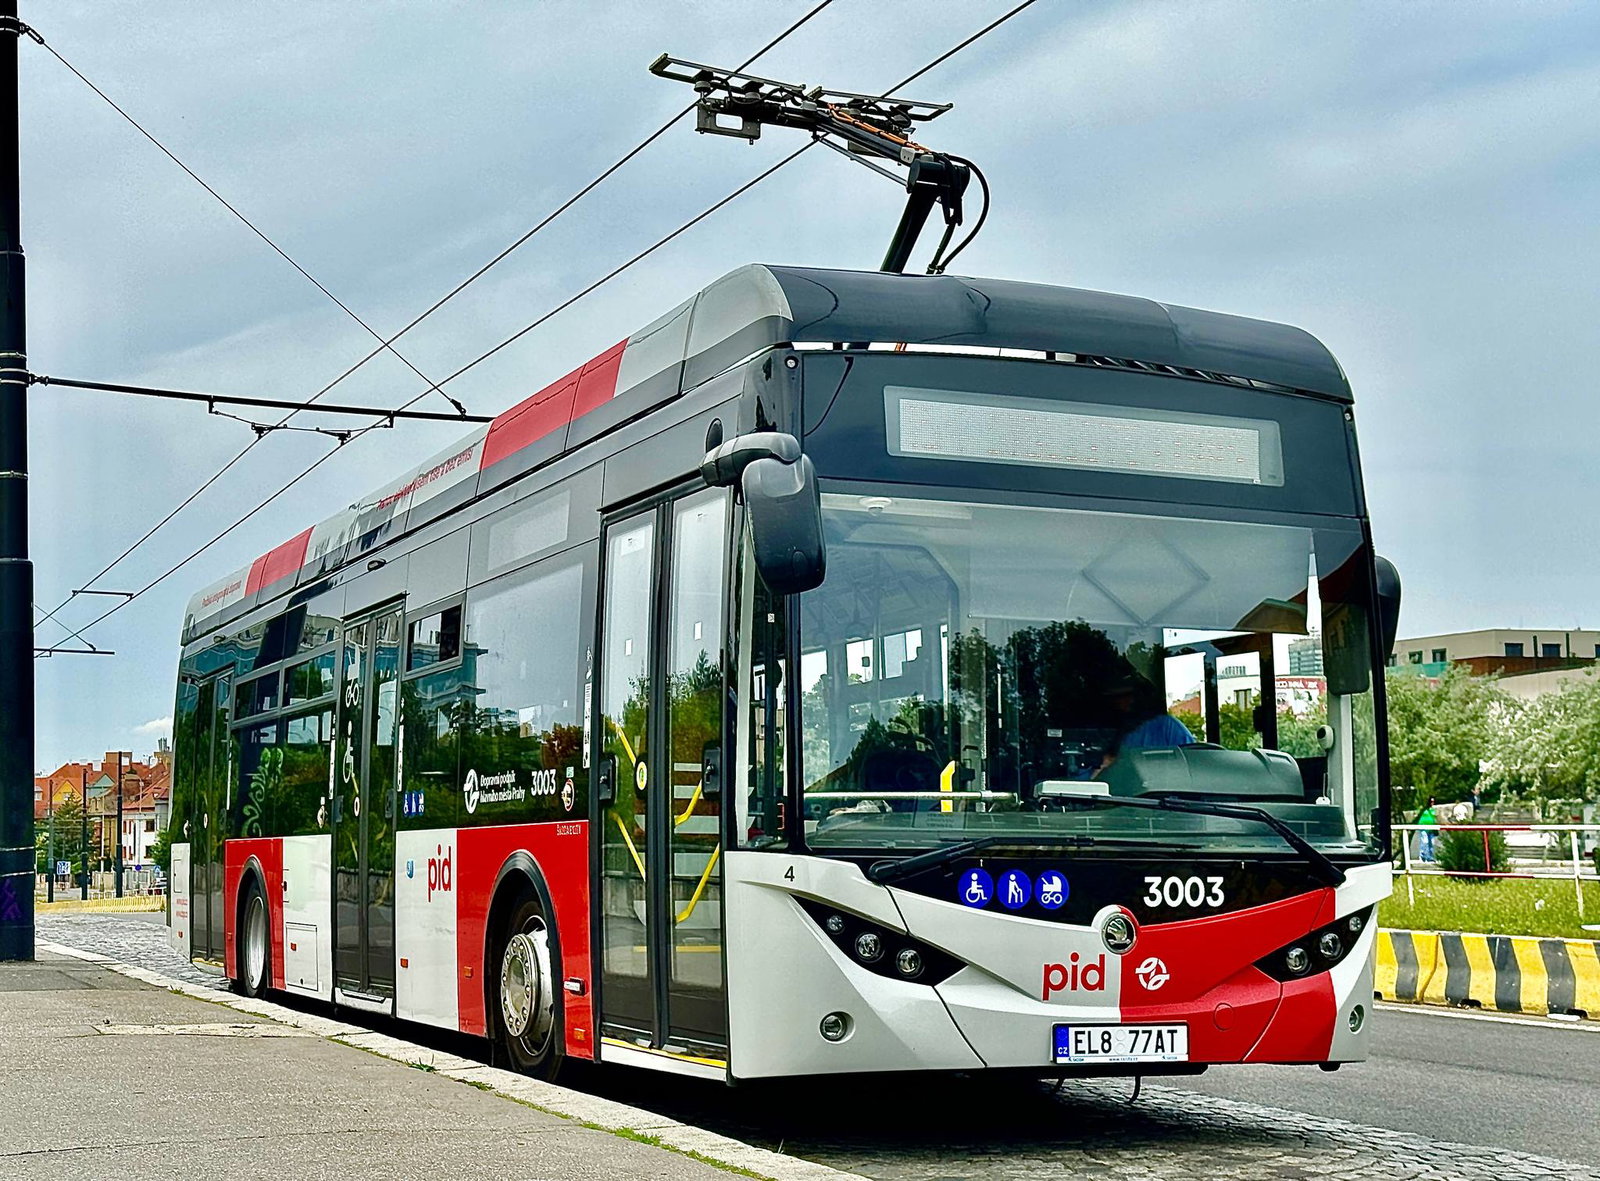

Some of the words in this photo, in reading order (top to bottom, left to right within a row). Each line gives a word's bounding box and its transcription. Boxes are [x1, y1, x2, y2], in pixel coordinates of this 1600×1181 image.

[480, 772, 500, 789] Dopravní
[500, 769, 516, 788] podnik
[531, 769, 557, 796] 3003
[428, 844, 452, 903] pid
[783, 865, 796, 882] 4
[1143, 876, 1225, 908] 3003
[1042, 951, 1106, 1001] pid
[1057, 1047, 1068, 1055] CZ
[1074, 1030, 1112, 1055] EL8
[1128, 1029, 1178, 1053] 77AT
